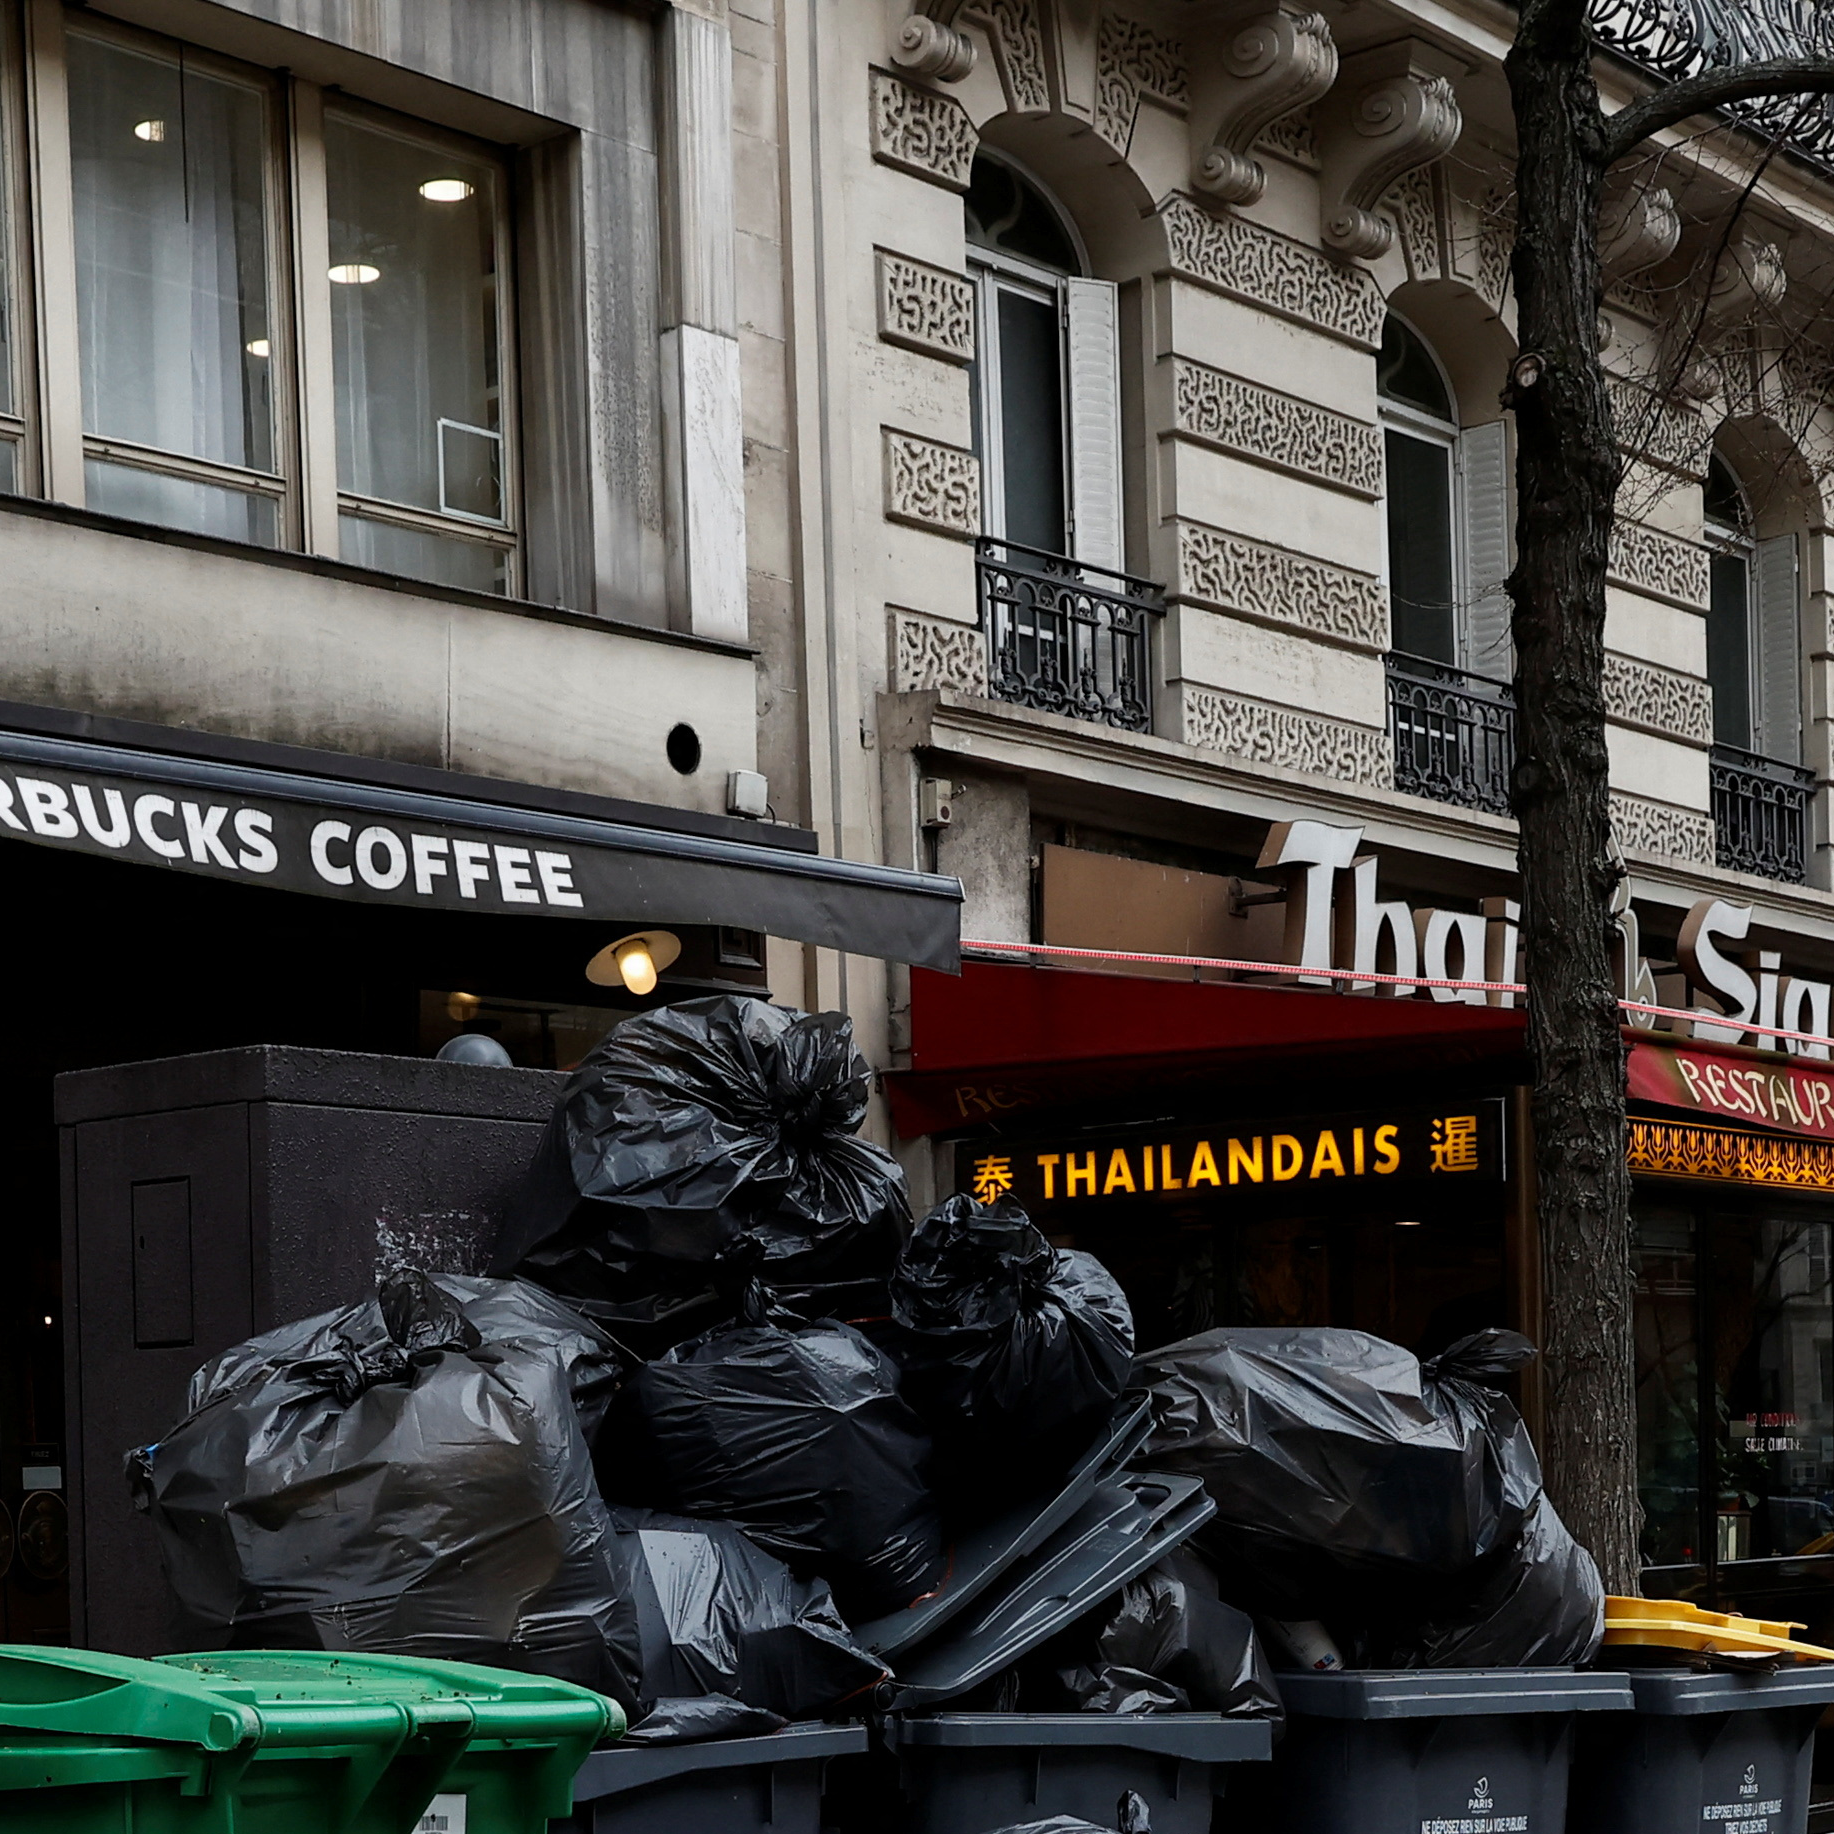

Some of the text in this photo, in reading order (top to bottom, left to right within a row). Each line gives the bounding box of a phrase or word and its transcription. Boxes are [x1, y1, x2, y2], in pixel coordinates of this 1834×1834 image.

[310, 820, 584, 908] COFFEE
[1263, 820, 1522, 1009] Thai
[1037, 1125, 1400, 1199] THAILANDAIS
[1430, 1116, 1480, 1173] 暹
[972, 1154, 1013, 1203] 泰
[1468, 1798, 1494, 1810] PARIS
[1739, 1784, 1759, 1795] PARIS
[1431, 1816, 1460, 1834] DÉPOSEZ
[1460, 1819, 1474, 1834] RIEN
[1474, 1818, 1486, 1834] SUR
[1494, 1817, 1506, 1833] VOIE
[1506, 1815, 1528, 1831] PUBLIQUE
